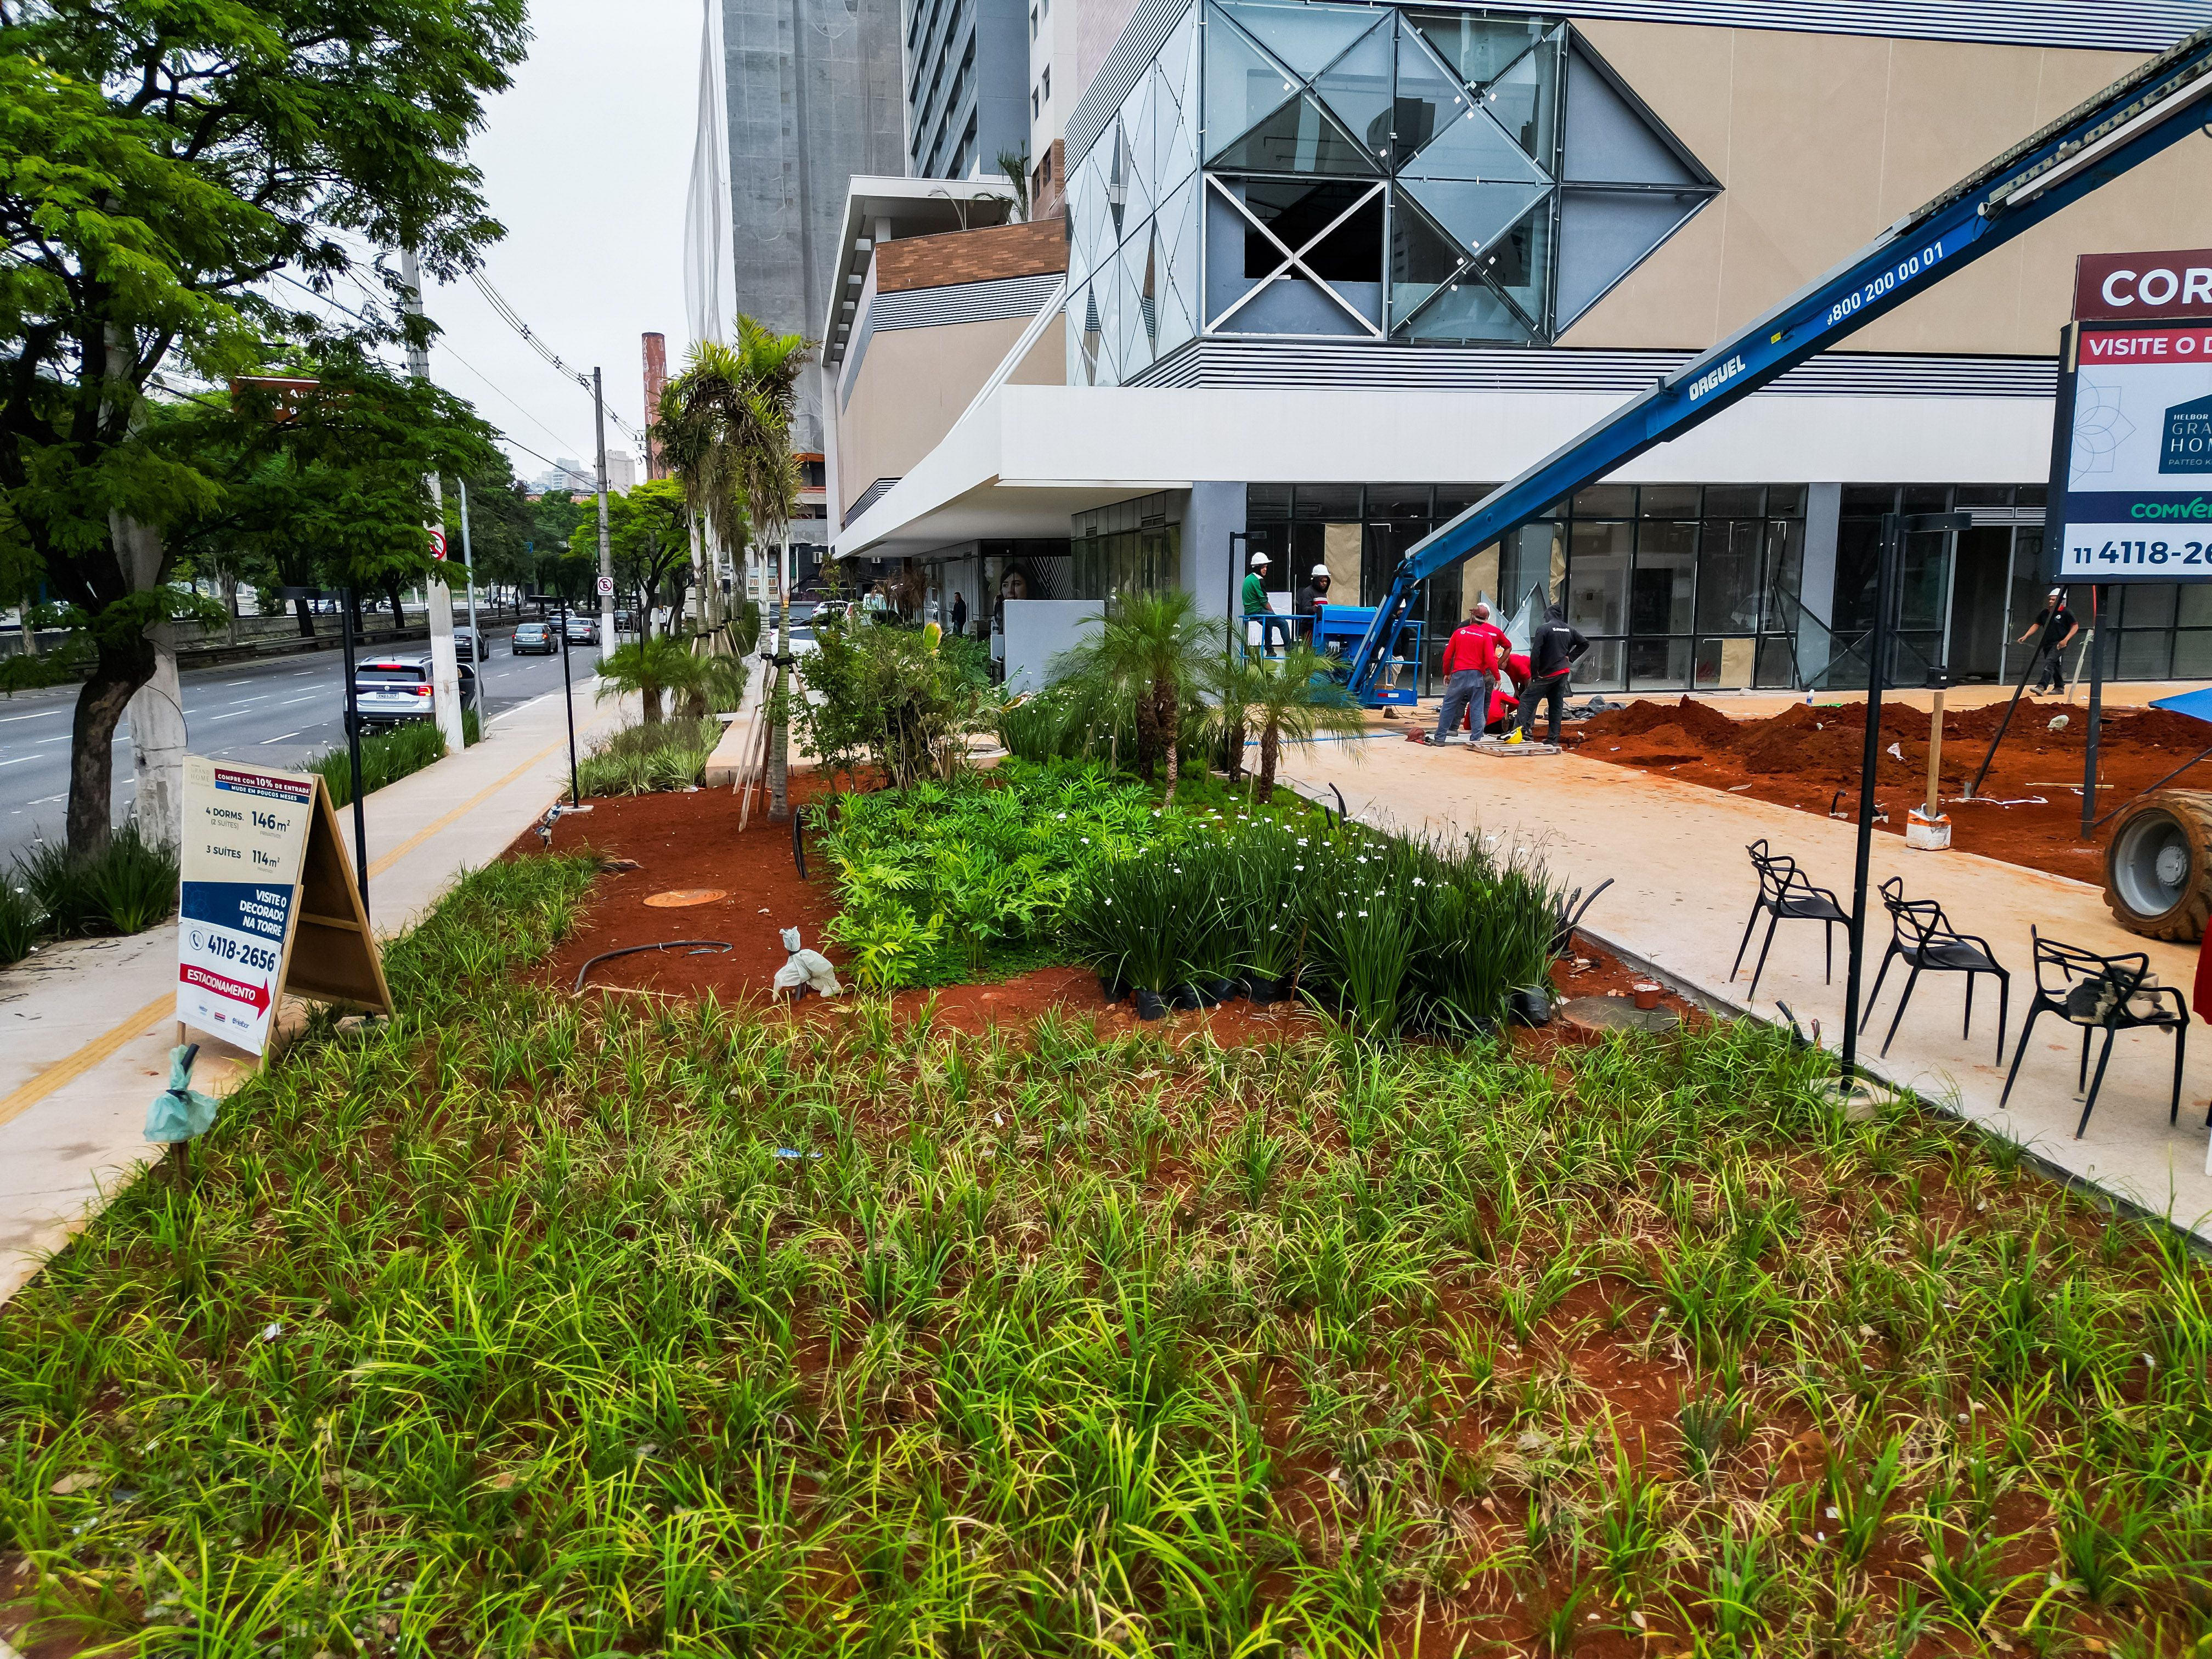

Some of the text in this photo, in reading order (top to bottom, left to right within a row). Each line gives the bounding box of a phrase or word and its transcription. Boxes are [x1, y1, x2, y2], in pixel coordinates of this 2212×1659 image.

[1865, 272, 1894, 302] 200
[1898, 257, 1919, 280] 00
[1923, 241, 1943, 266] 01
[2102, 268, 2212, 307] COR
[2089, 337, 2169, 356] VISITE
[2175, 337, 2196, 354] O
[1689, 354, 1746, 401] ORGUEL
[2171, 438, 2212, 452] HO
[2073, 548, 2092, 564] 11
[217, 774, 241, 783] COMPRE
[256, 777, 274, 788] 10%
[257, 789, 279, 798] POUCOS
[280, 793, 297, 801] MESES
[205, 806, 211, 815] 4
[213, 808, 244, 821] DORMS.
[251, 811, 276, 830] 146
[206, 845, 211, 854] 3
[213, 846, 241, 859] SUÍTES
[252, 850, 268, 866] 114
[256, 889, 287, 908] VISITE O
[239, 900, 284, 922] DECORADO
[242, 915, 283, 937] NA TORRE
[207, 934, 276, 972] 4118-2656
[187, 969, 256, 1001] ESTACIONAMENTO
